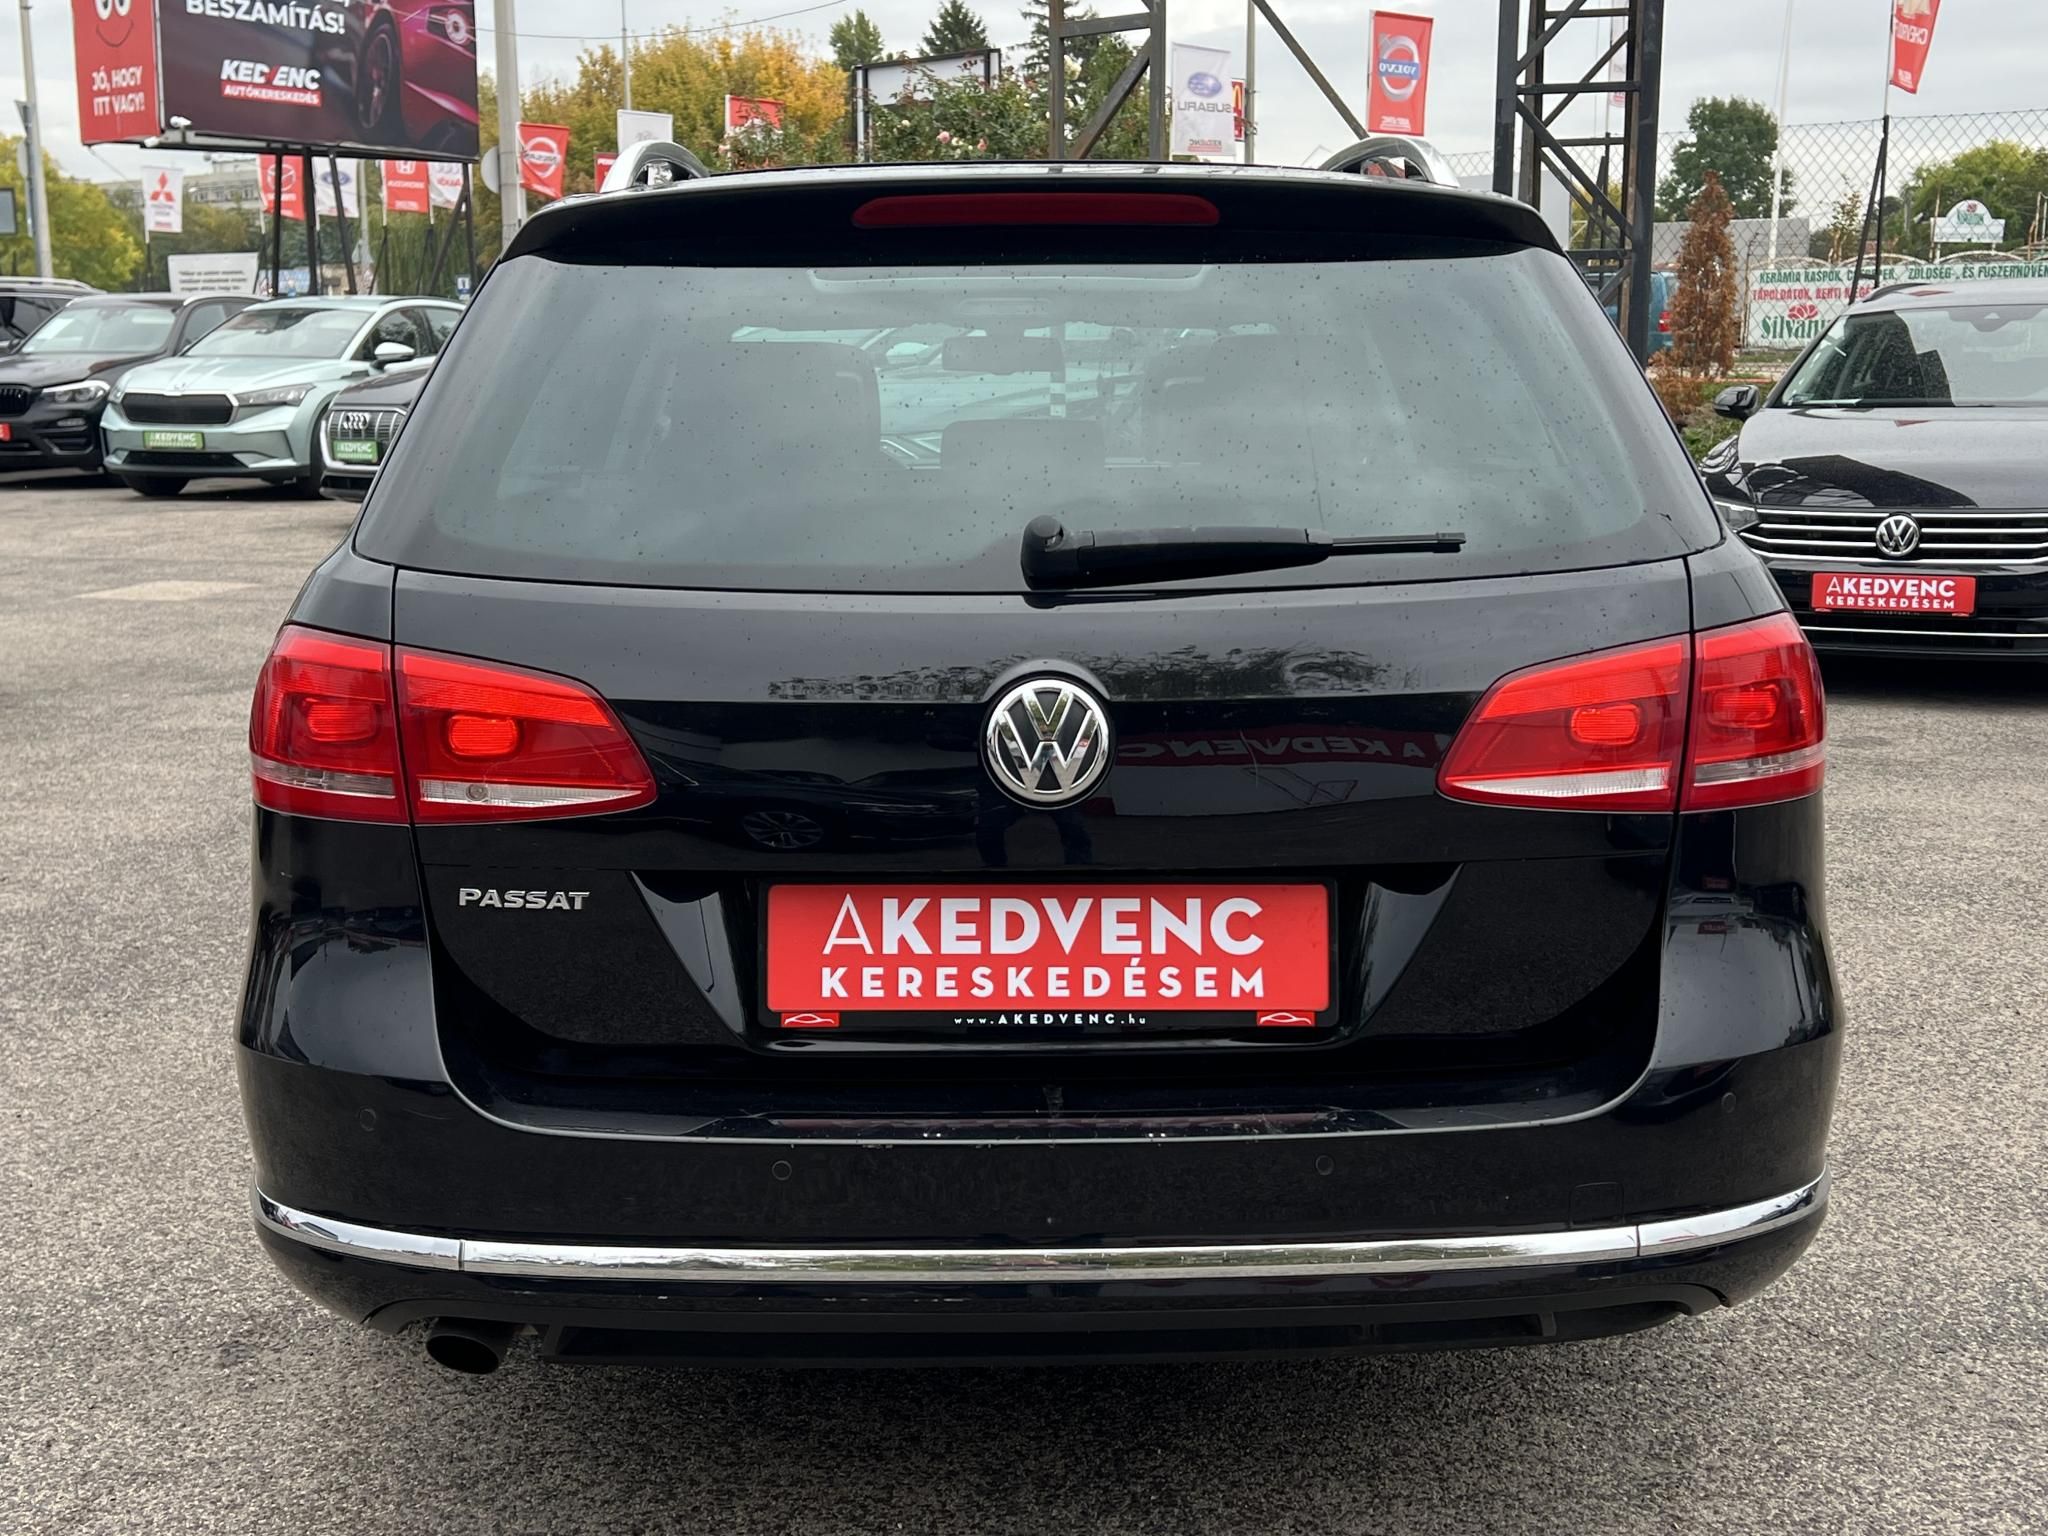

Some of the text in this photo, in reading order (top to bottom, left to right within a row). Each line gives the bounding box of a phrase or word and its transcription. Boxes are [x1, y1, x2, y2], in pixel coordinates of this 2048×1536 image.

[111, 65, 143, 89] HOGY
[1826, 576, 1956, 597] AKEDVENC
[1825, 595, 1955, 609] KERESKEDÉSEM
[459, 888, 590, 910] PASSAT
[822, 893, 1265, 956] AKEDVENC
[821, 958, 1265, 998] KERESKEDÉSEM
[954, 1013, 1146, 1025] www.AKEDVENC.hu
